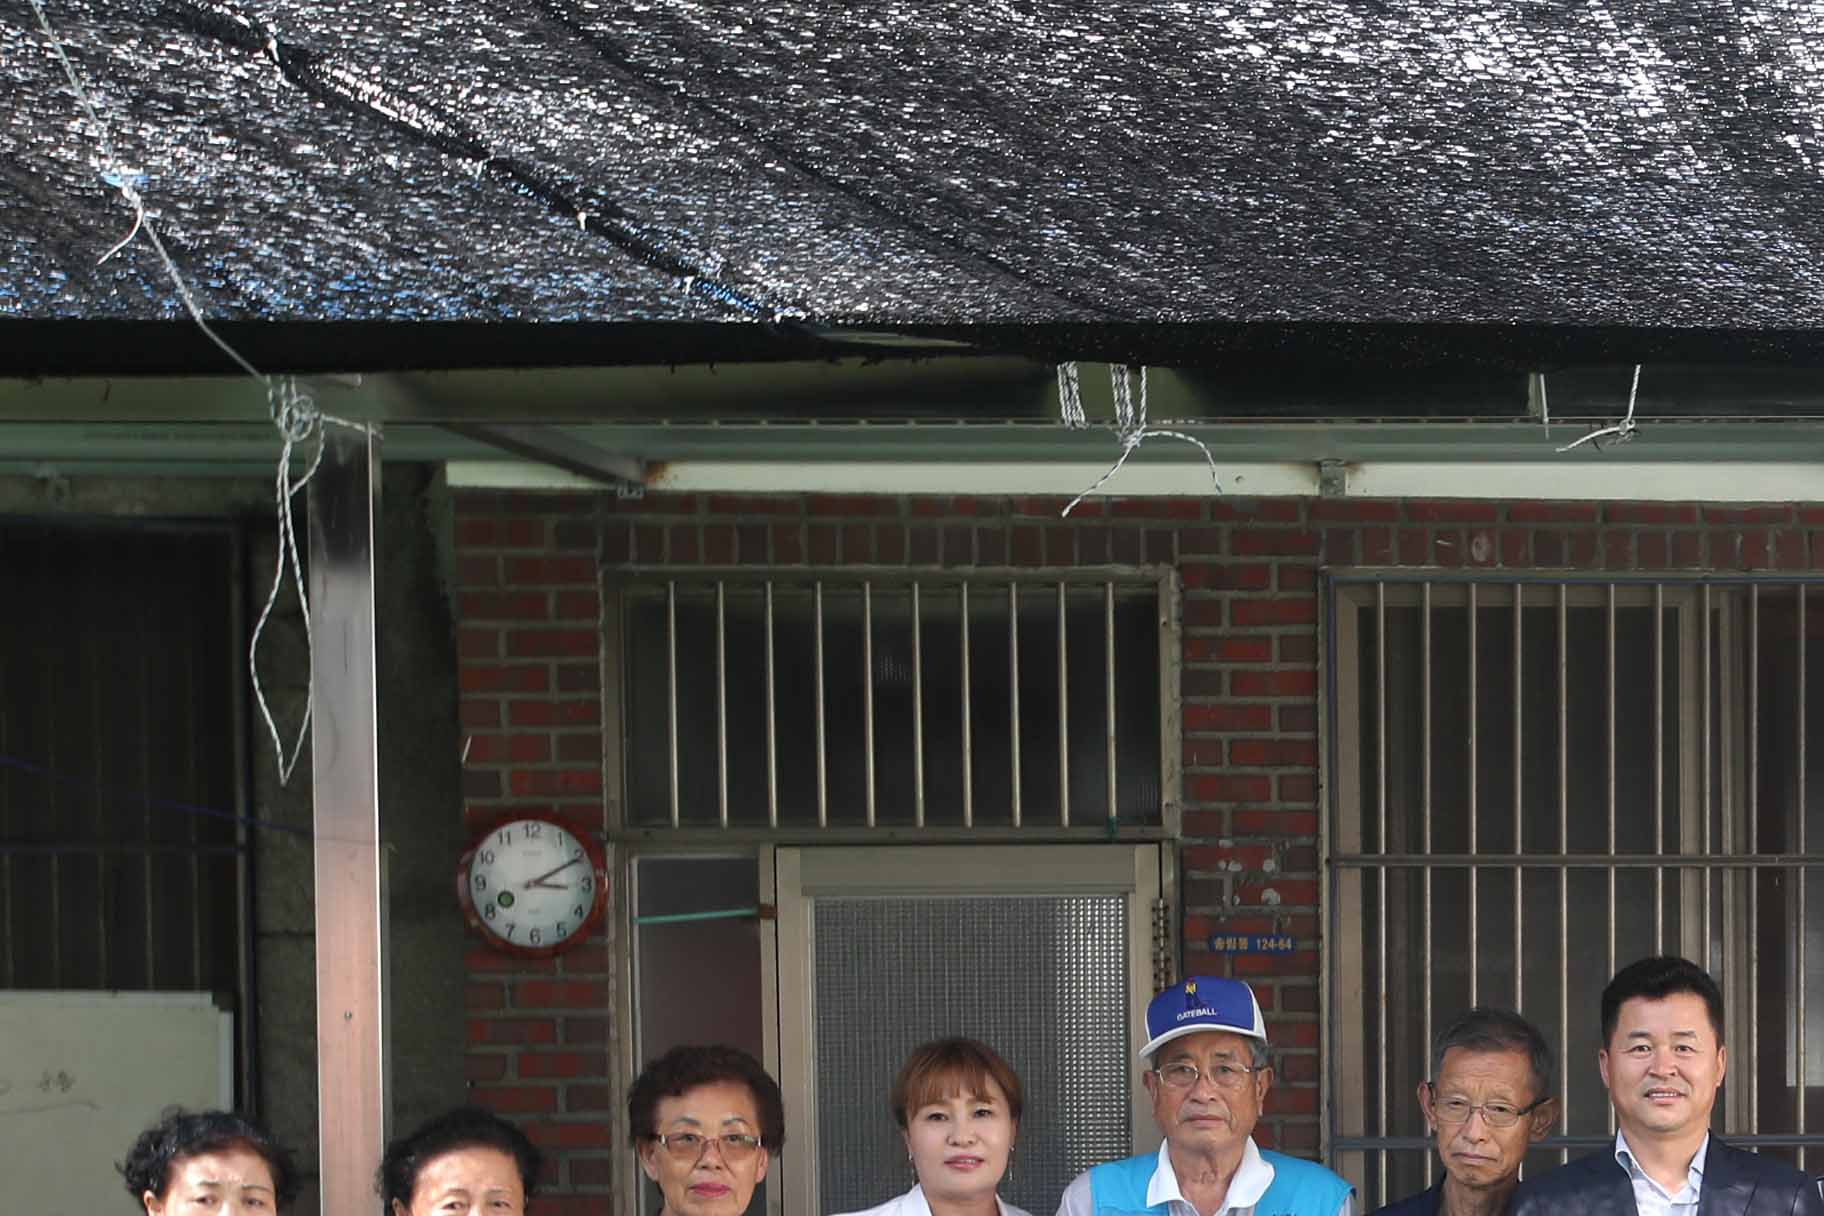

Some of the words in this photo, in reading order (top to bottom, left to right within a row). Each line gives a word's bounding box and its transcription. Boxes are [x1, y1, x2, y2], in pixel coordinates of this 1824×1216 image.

[497, 830, 513, 847] 11
[523, 822, 541, 840] 12
[479, 851, 496, 866] 10
[474, 875, 487, 891] 9
[580, 877, 593, 893] 3
[484, 903, 496, 920] 8
[574, 904, 584, 919] 4
[504, 923, 516, 940] 7
[528, 928, 541, 945] 6
[556, 921, 567, 938] 5
[1176, 1007, 1217, 1022] GATEBALL
